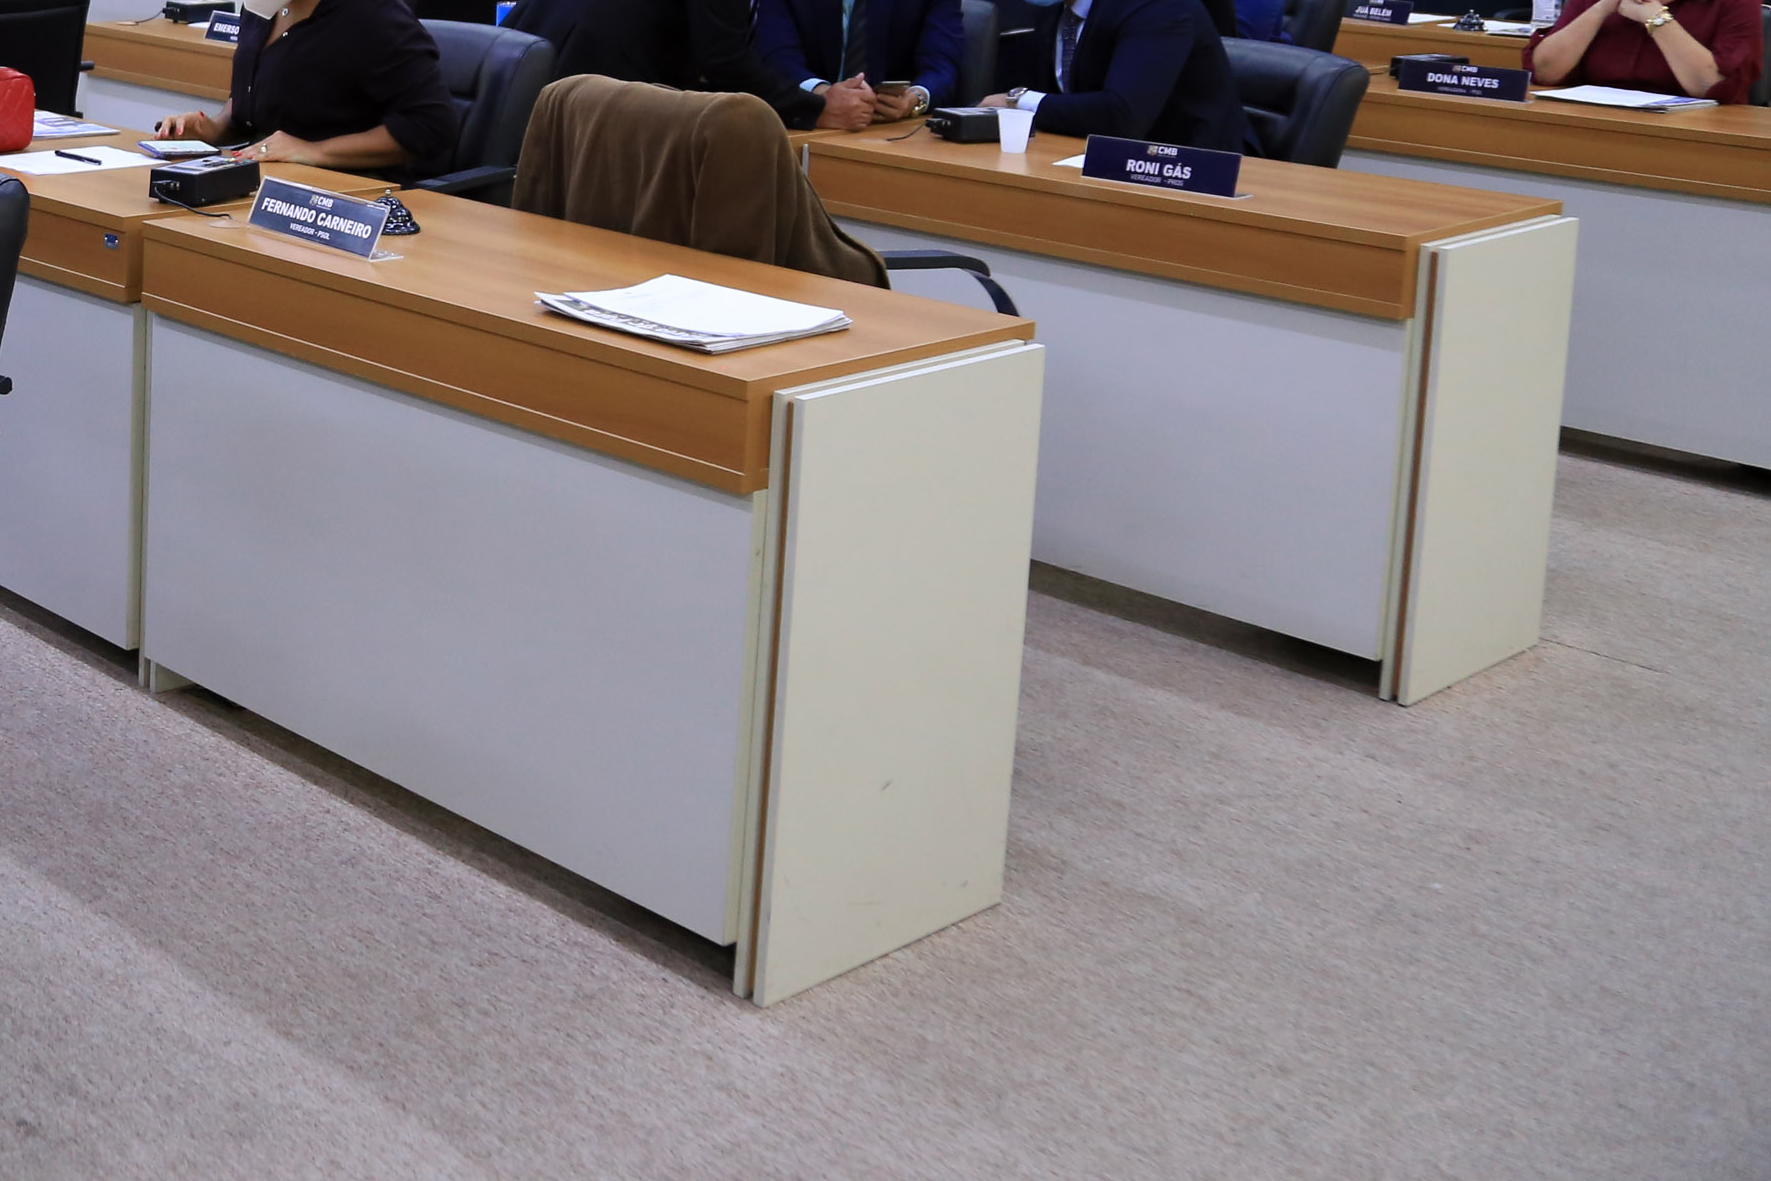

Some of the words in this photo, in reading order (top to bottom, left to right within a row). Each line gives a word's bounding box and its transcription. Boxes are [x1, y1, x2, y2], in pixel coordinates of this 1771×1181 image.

[1355, 5, 1369, 15] JUÁ
[1370, 6, 1392, 17] BELÉM
[1461, 65, 1478, 73] CMB
[1427, 72, 1458, 85] DONA
[1461, 75, 1499, 89] NEVES
[1157, 146, 1178, 156] CMB
[1126, 159, 1160, 175] RONI
[1162, 163, 1192, 179] GÁS
[317, 196, 334, 208] CMB
[261, 197, 316, 223] FERNANDO
[316, 213, 372, 239] CARNEIRO
[289, 222, 315, 236] VEREADOR
